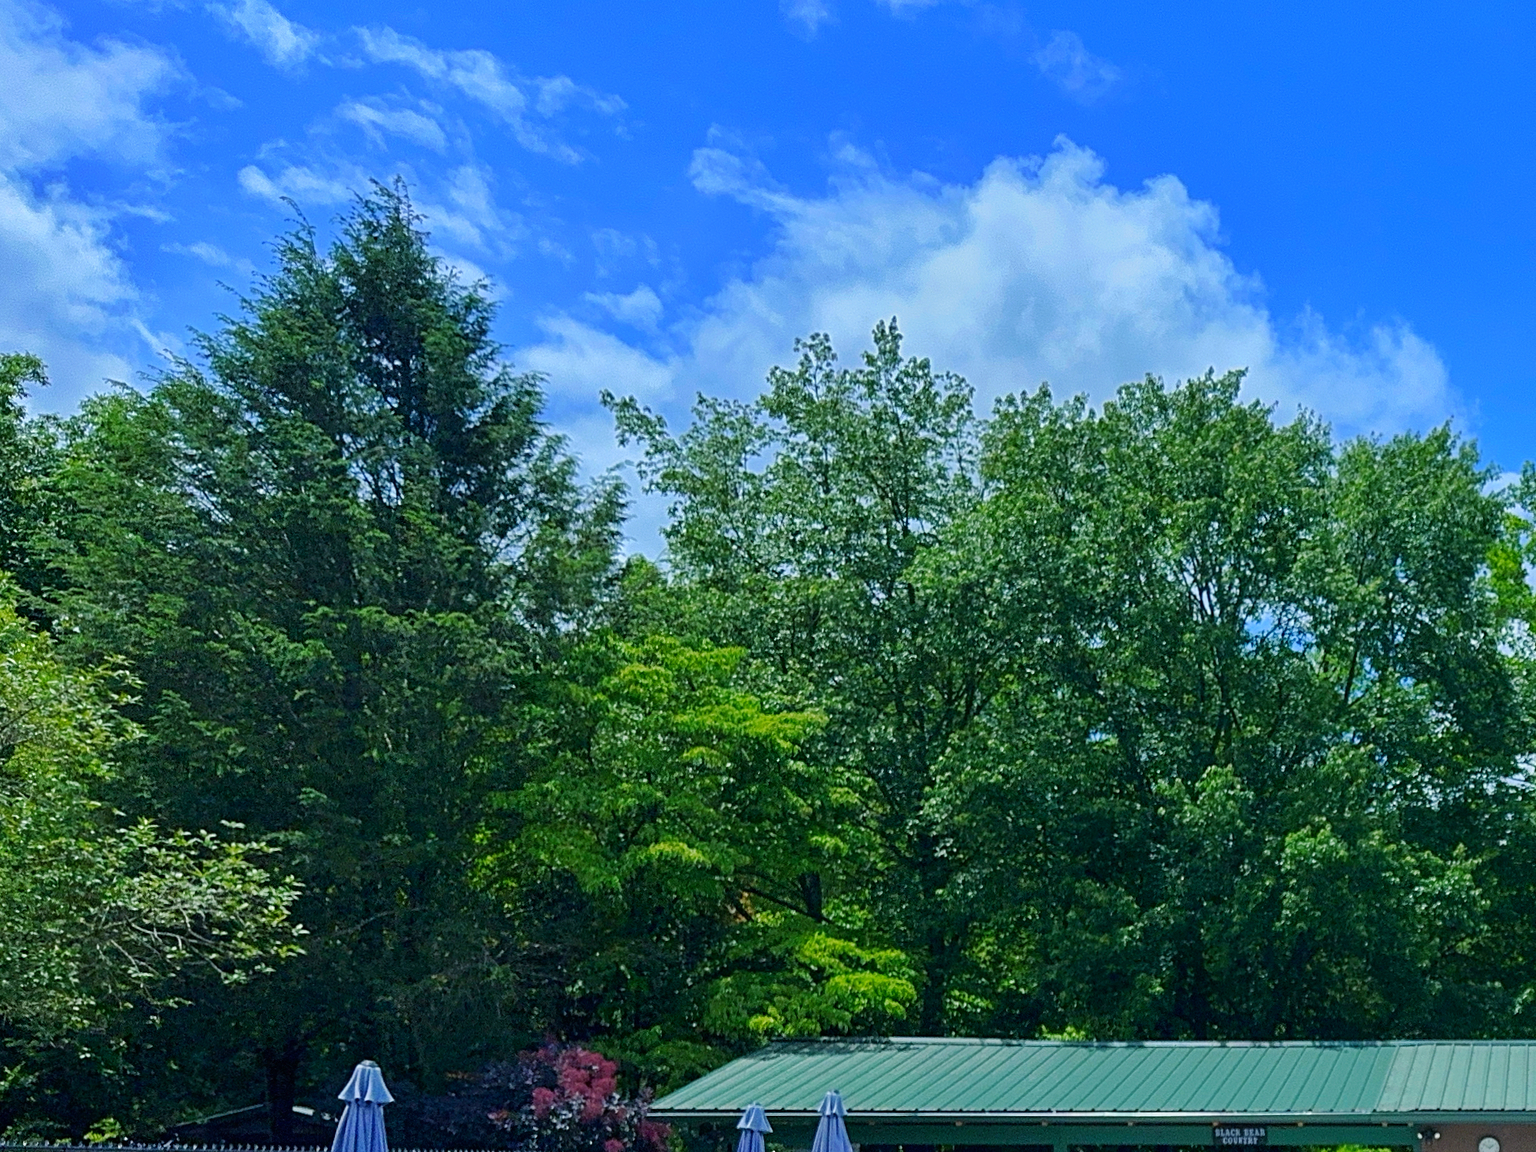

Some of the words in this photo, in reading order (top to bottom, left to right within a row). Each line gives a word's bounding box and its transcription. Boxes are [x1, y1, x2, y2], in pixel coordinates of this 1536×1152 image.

[1214, 1128, 1241, 1138] BLACK
[1244, 1128, 1266, 1137] BEAR
[1222, 1137, 1259, 1145] COUNTRY
